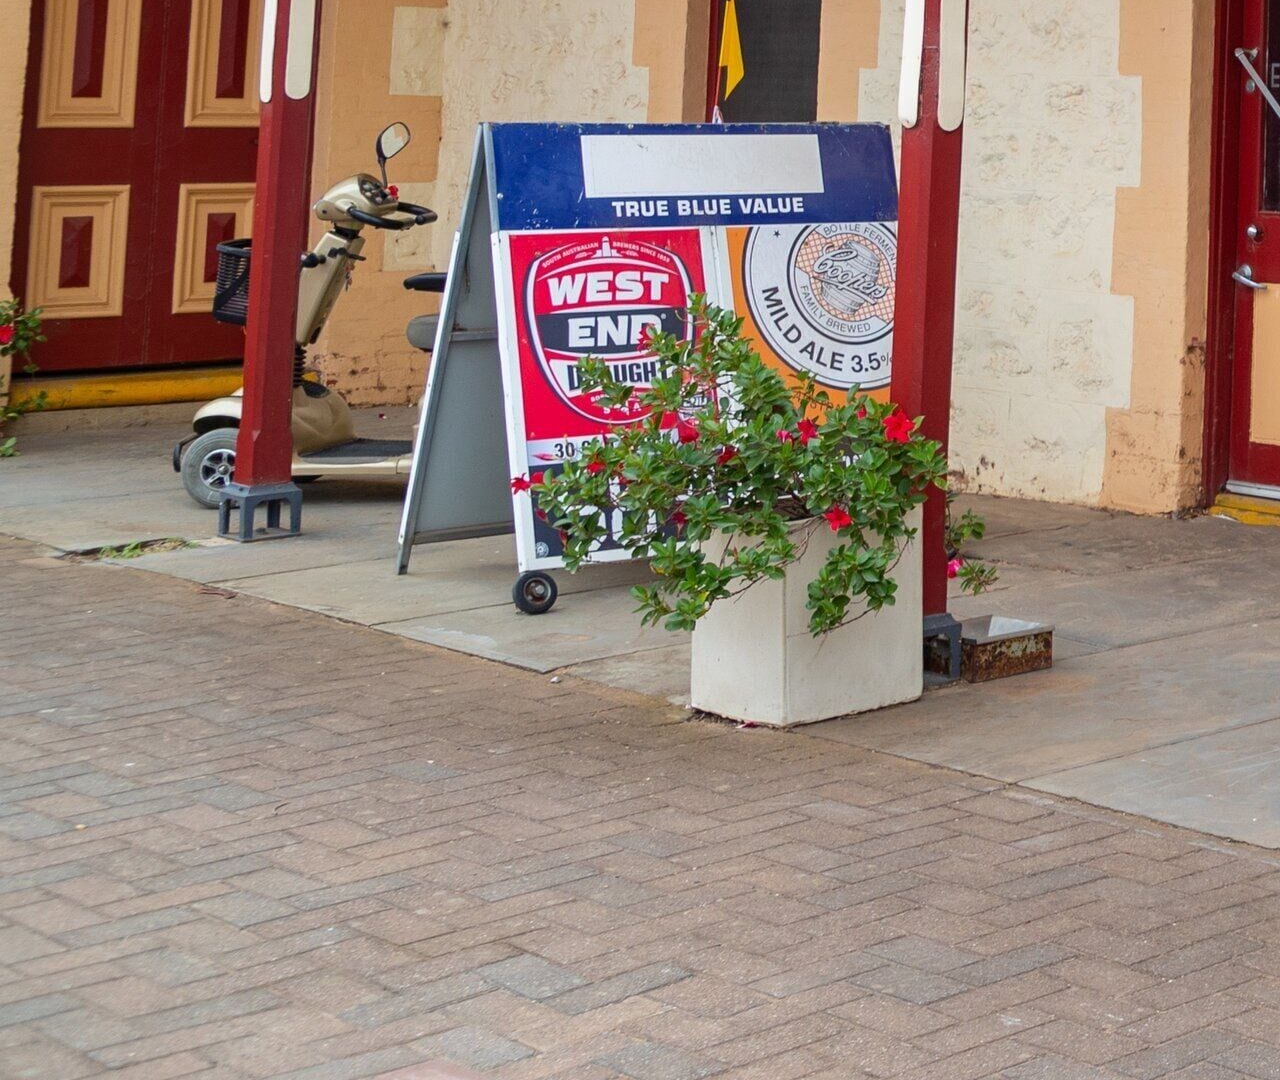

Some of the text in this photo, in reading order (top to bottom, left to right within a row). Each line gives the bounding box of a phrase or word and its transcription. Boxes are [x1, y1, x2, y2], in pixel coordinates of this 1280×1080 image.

[611, 197, 805, 218] TRUE BLUE VALUE
[542, 252, 562, 268] SOUTH
[562, 241, 599, 257] AUSTRALIAN
[612, 241, 640, 251] BREWERS
[640, 246, 656, 257] SINCE
[863, 226, 896, 263] FERMEN
[547, 271, 670, 306] WEST
[800, 285, 871, 333] FAMILY BREWED
[762, 286, 802, 344] MILD
[799, 341, 845, 372] ALE
